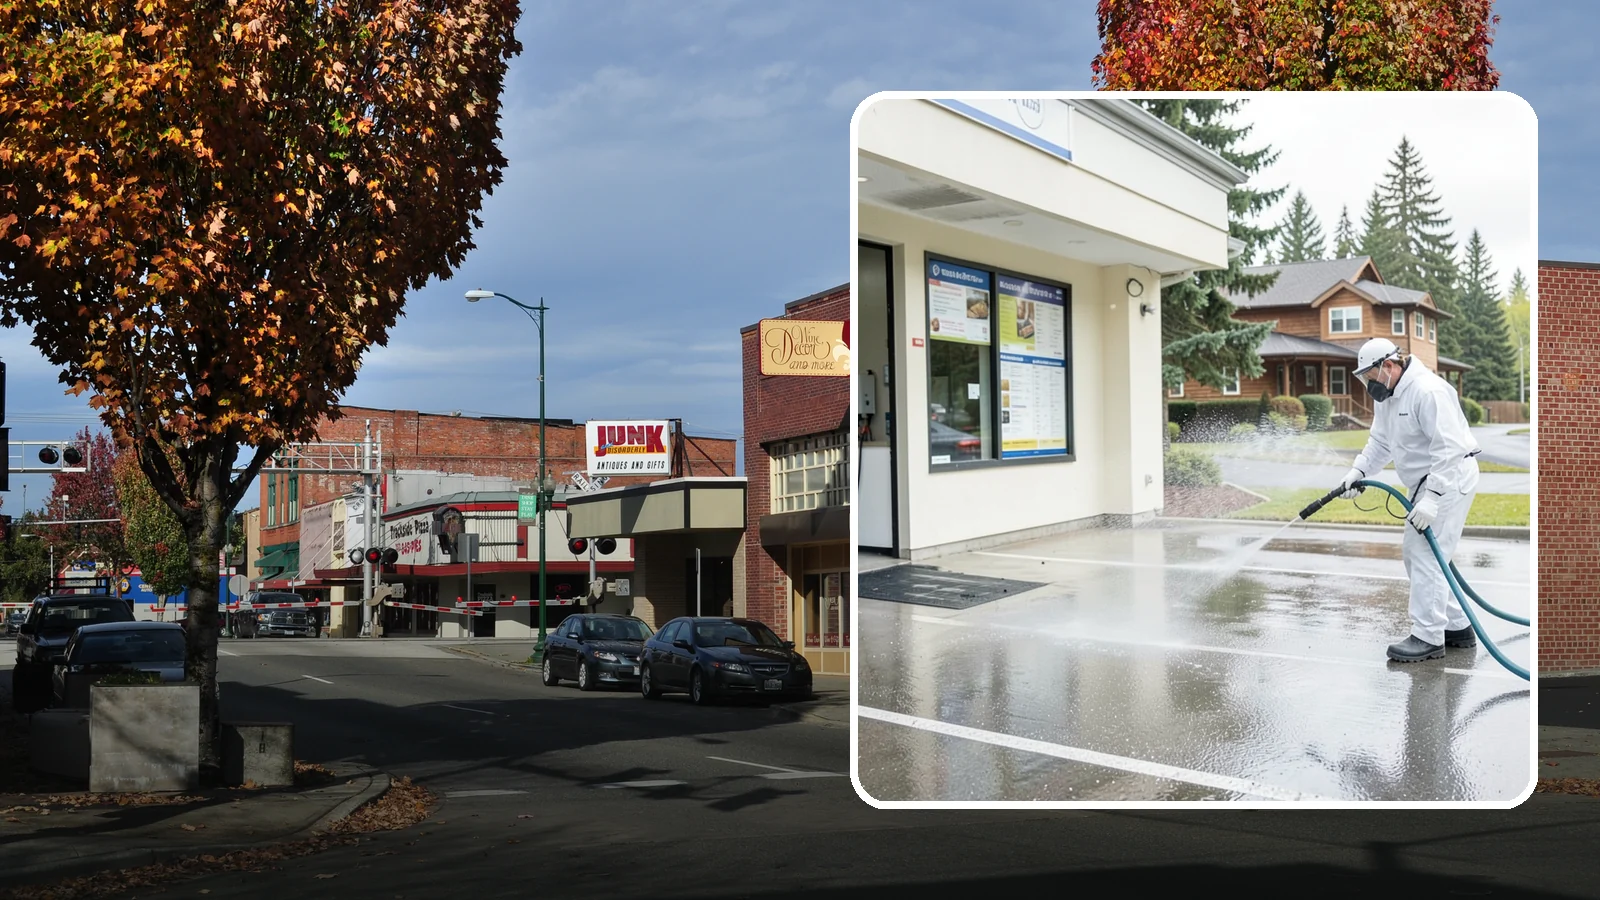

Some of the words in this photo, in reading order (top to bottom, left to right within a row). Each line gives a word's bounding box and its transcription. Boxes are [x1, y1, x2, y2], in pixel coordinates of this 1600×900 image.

[596, 425, 666, 457] JUNK
[607, 446, 646, 454] DISORDERLY
[597, 461, 628, 470] ANTIQUES
[631, 461, 643, 470] AND
[647, 460, 666, 469] GIFTS
